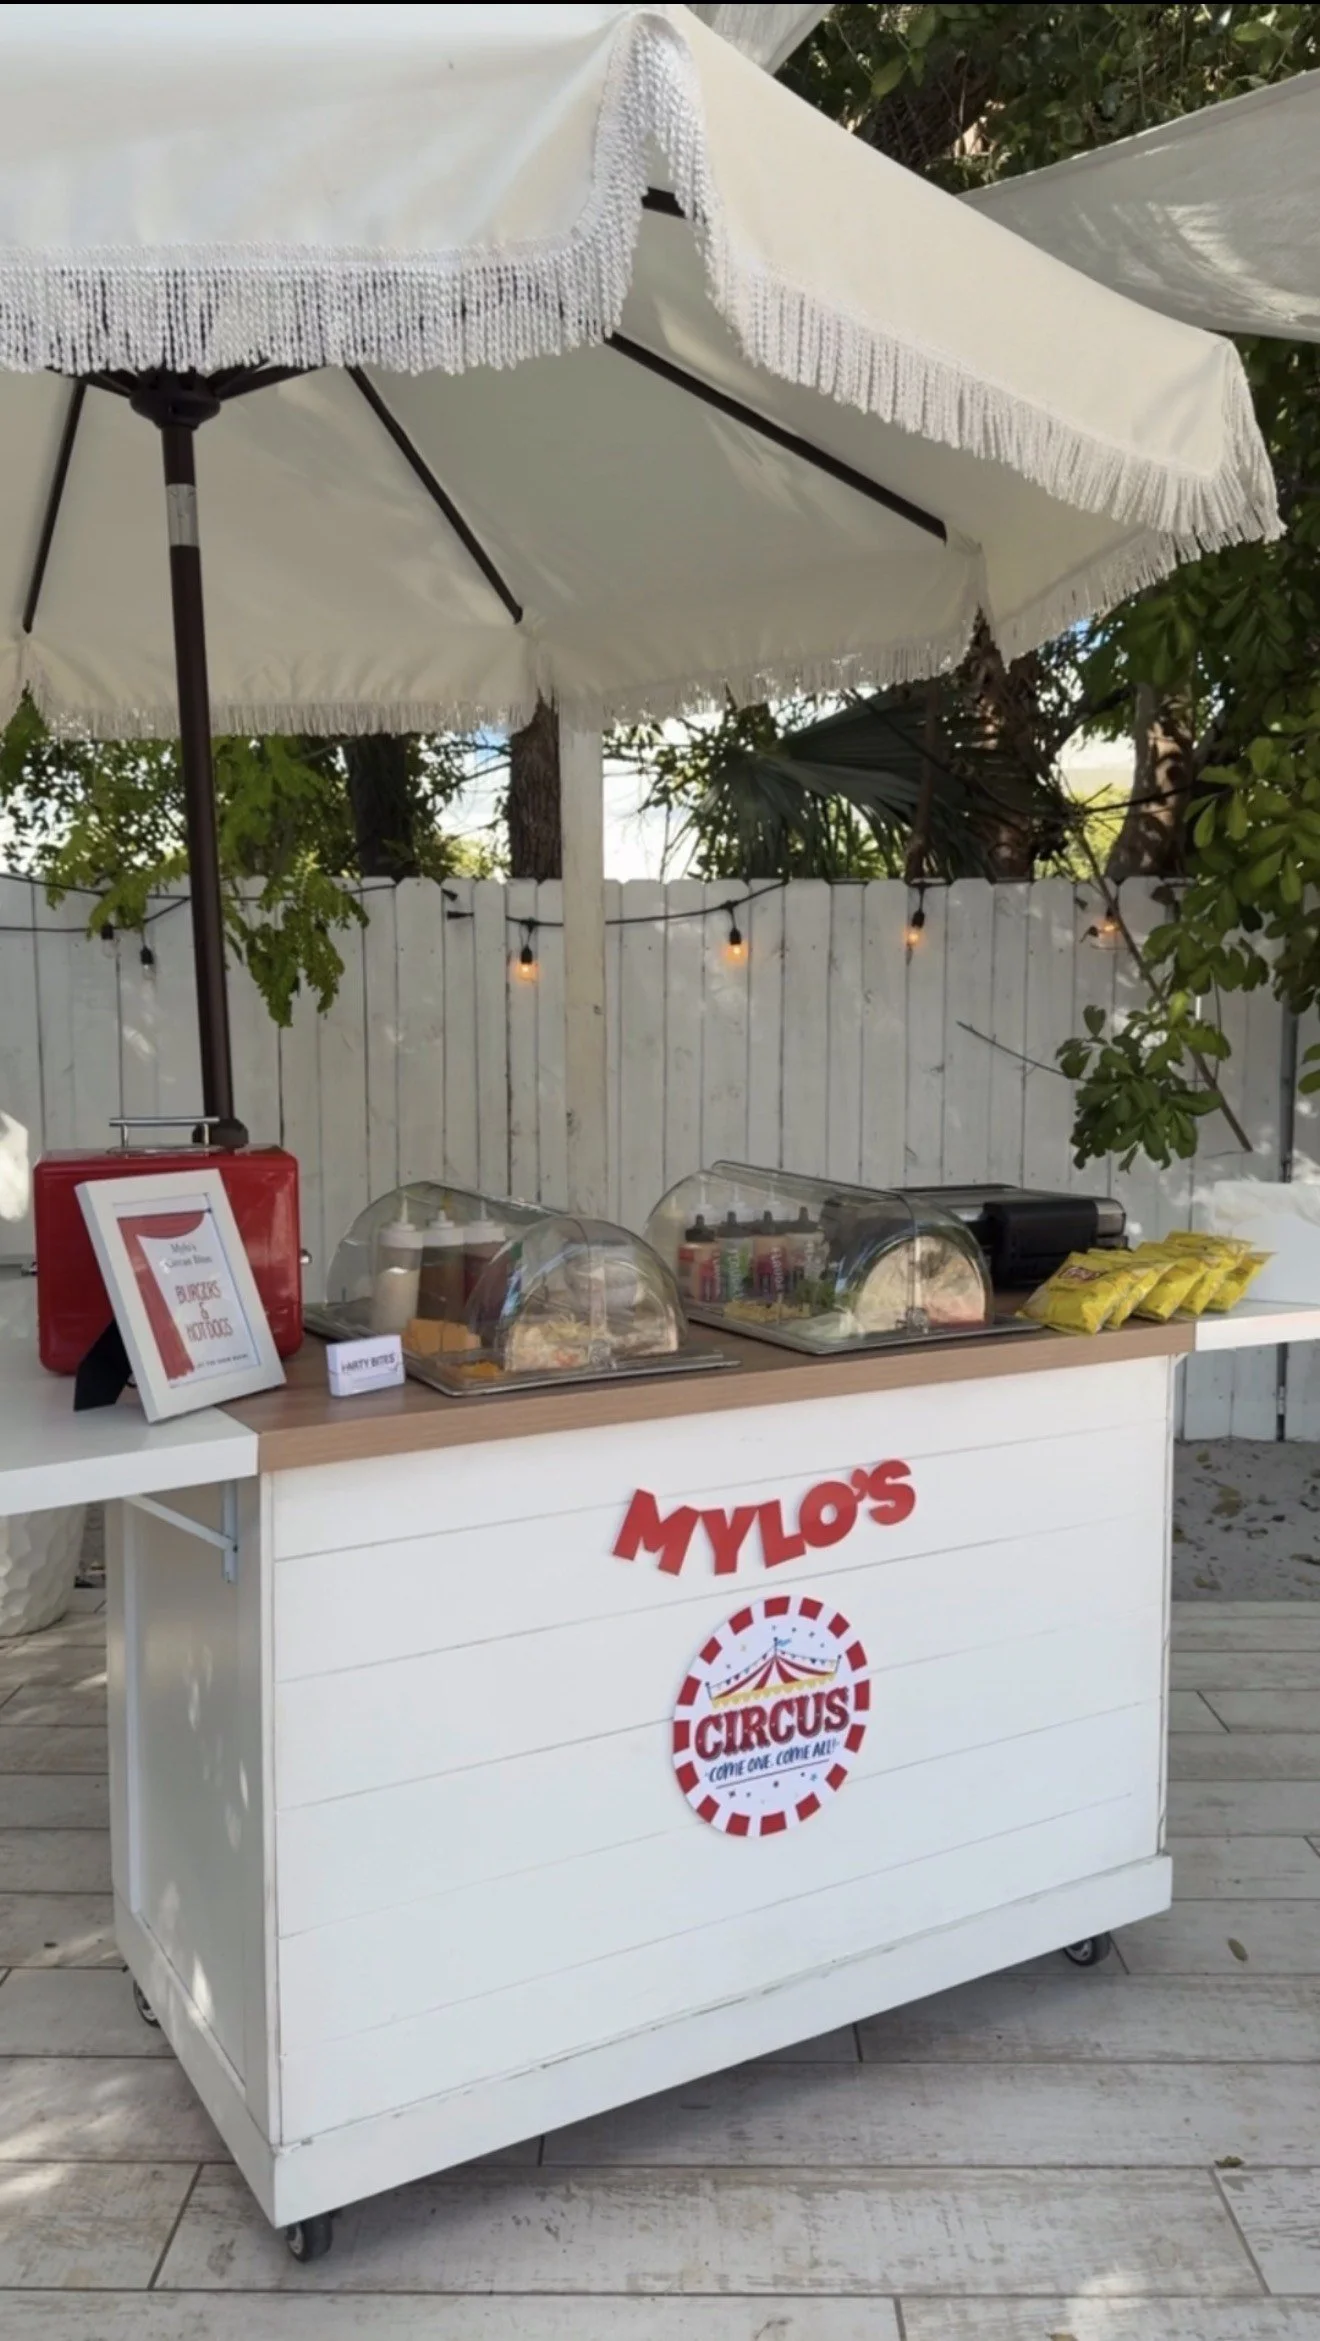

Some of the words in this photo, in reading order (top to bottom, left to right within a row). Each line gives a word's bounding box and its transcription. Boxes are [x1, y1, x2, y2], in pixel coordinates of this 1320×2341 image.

[175, 1280, 221, 1305] BURGERS
[612, 1459, 916, 1576] MYLO'S
[695, 1687, 850, 1762] CIRCUS
[708, 1759, 745, 1783] COME
[776, 1744, 812, 1766] COME
